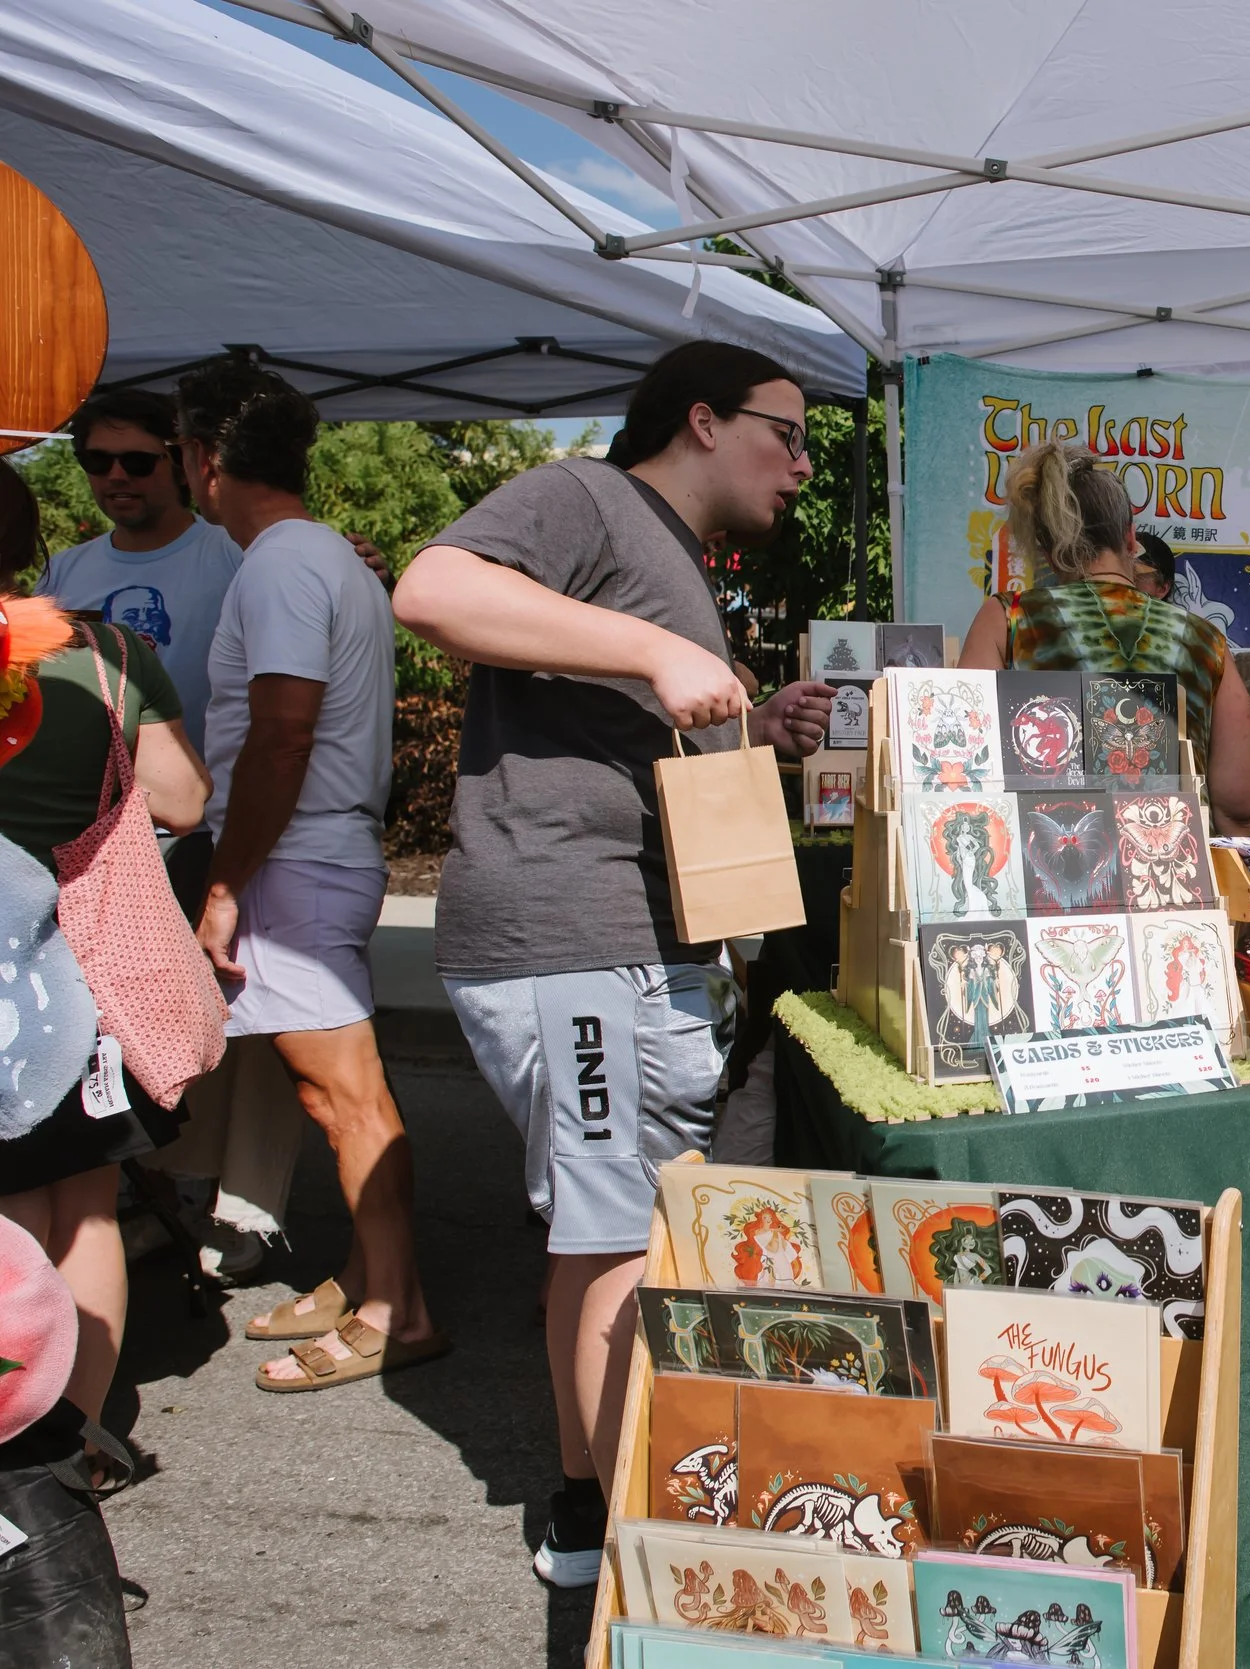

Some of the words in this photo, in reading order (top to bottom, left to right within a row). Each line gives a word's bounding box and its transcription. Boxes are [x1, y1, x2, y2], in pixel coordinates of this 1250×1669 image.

[983, 395, 1079, 452] The
[1087, 404, 1188, 460] Last
[1012, 1039, 1082, 1065] CARDS
[1087, 1040, 1103, 1057] &
[1107, 1030, 1204, 1056] STICKERS
[572, 1016, 612, 1141] AND1
[997, 1323, 1032, 1350] THE
[1023, 1338, 1112, 1392] FUNGUS
